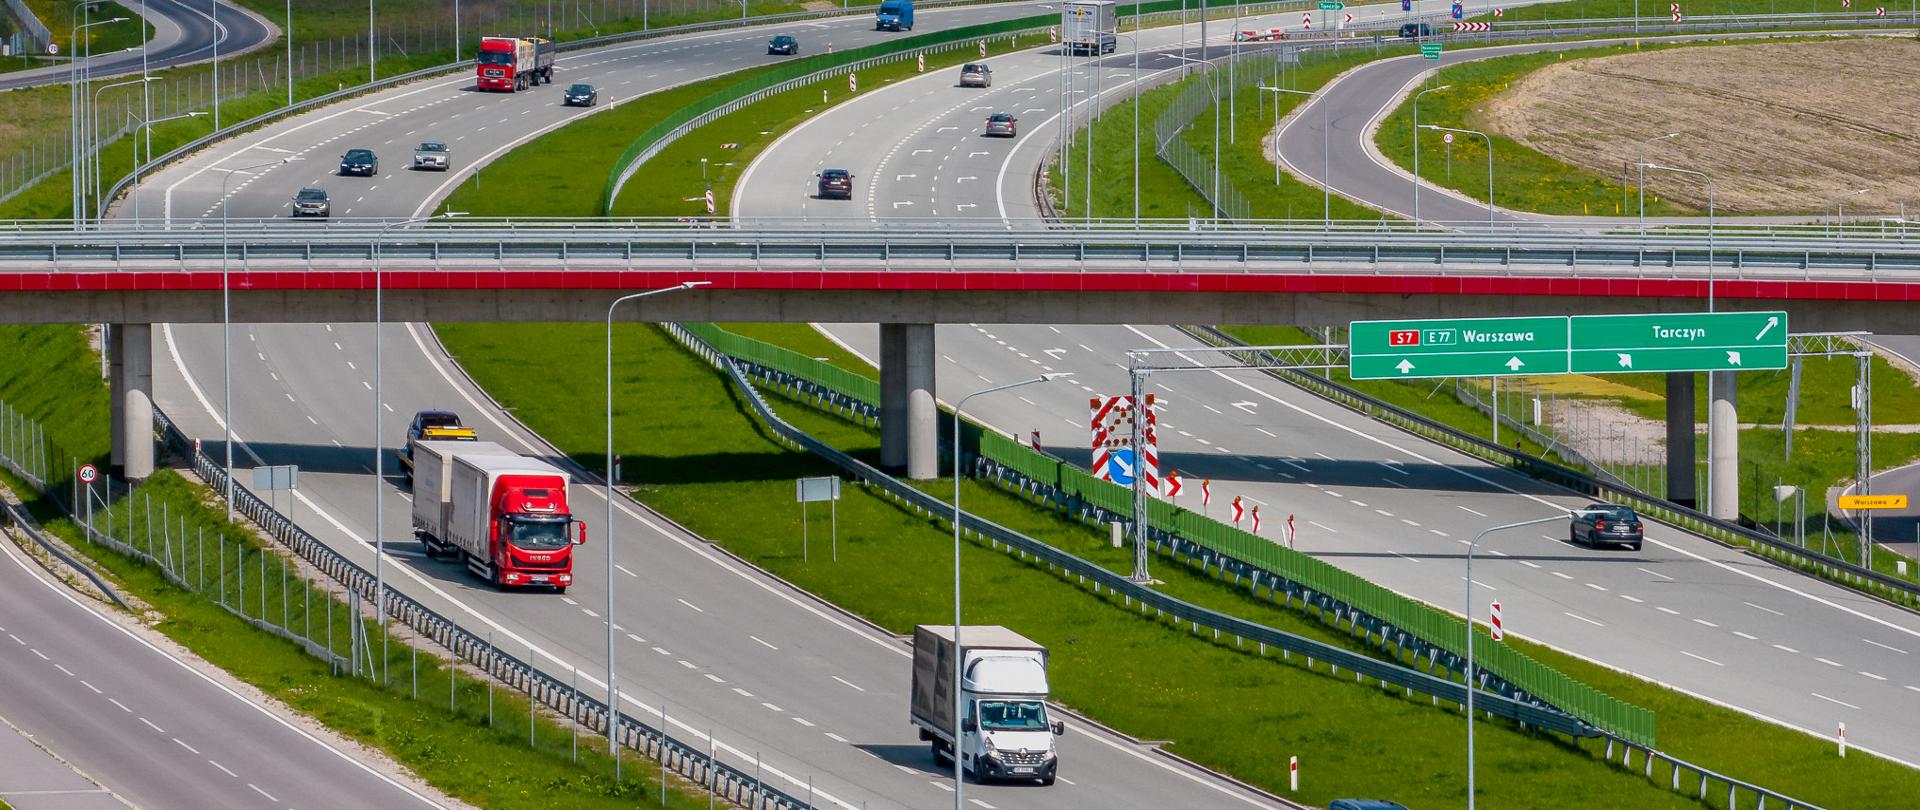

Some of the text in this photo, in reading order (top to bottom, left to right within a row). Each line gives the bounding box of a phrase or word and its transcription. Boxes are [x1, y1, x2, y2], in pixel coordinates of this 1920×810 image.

[1396, 332, 1413, 344] S 7
[1429, 331, 1451, 343] E 77
[1462, 329, 1534, 343] Warszawa
[1652, 325, 1705, 341] Tarczyn
[82, 469, 94, 479] 60
